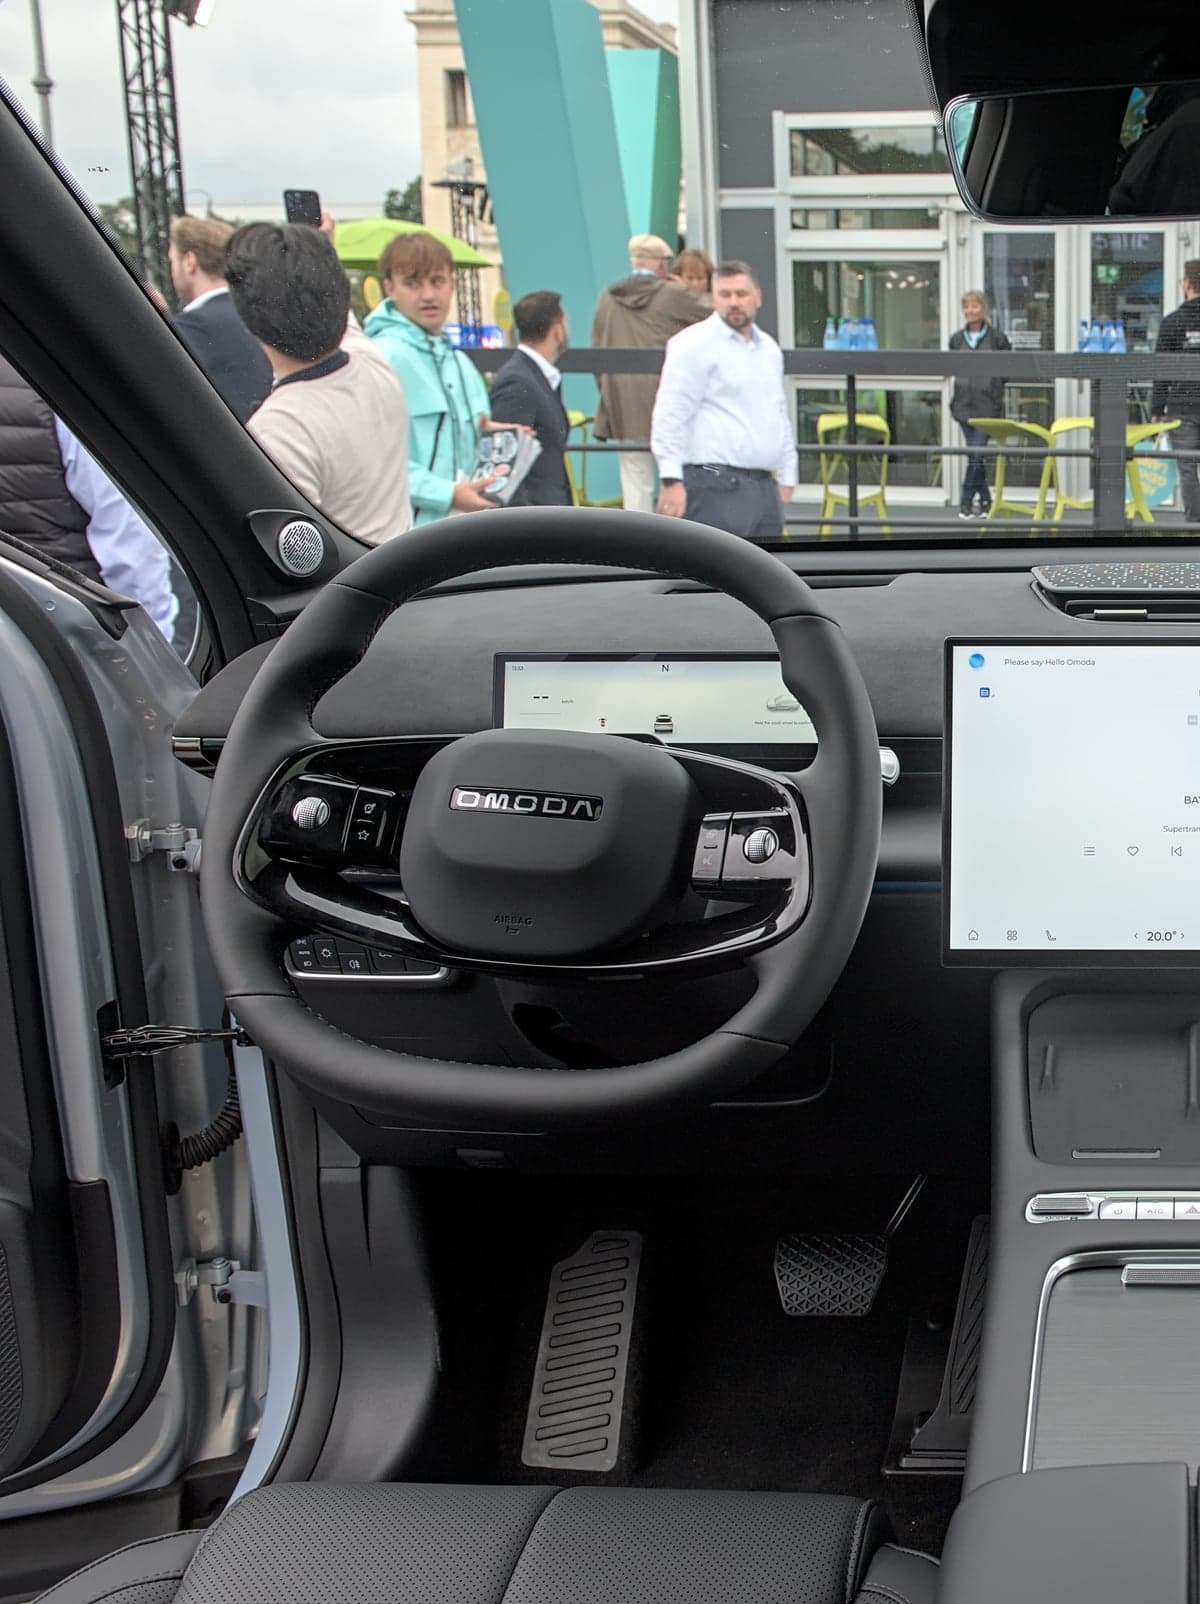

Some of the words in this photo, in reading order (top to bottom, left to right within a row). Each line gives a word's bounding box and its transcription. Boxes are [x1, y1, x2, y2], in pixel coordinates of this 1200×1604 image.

[1004, 658, 1030, 666] Please
[1030, 659, 1044, 667] say
[1045, 658, 1065, 666] Hello
[1066, 658, 1096, 666] Omoda
[661, 664, 670, 673] N
[456, 790, 595, 818] OMODA
[494, 914, 534, 926] AIRBAG
